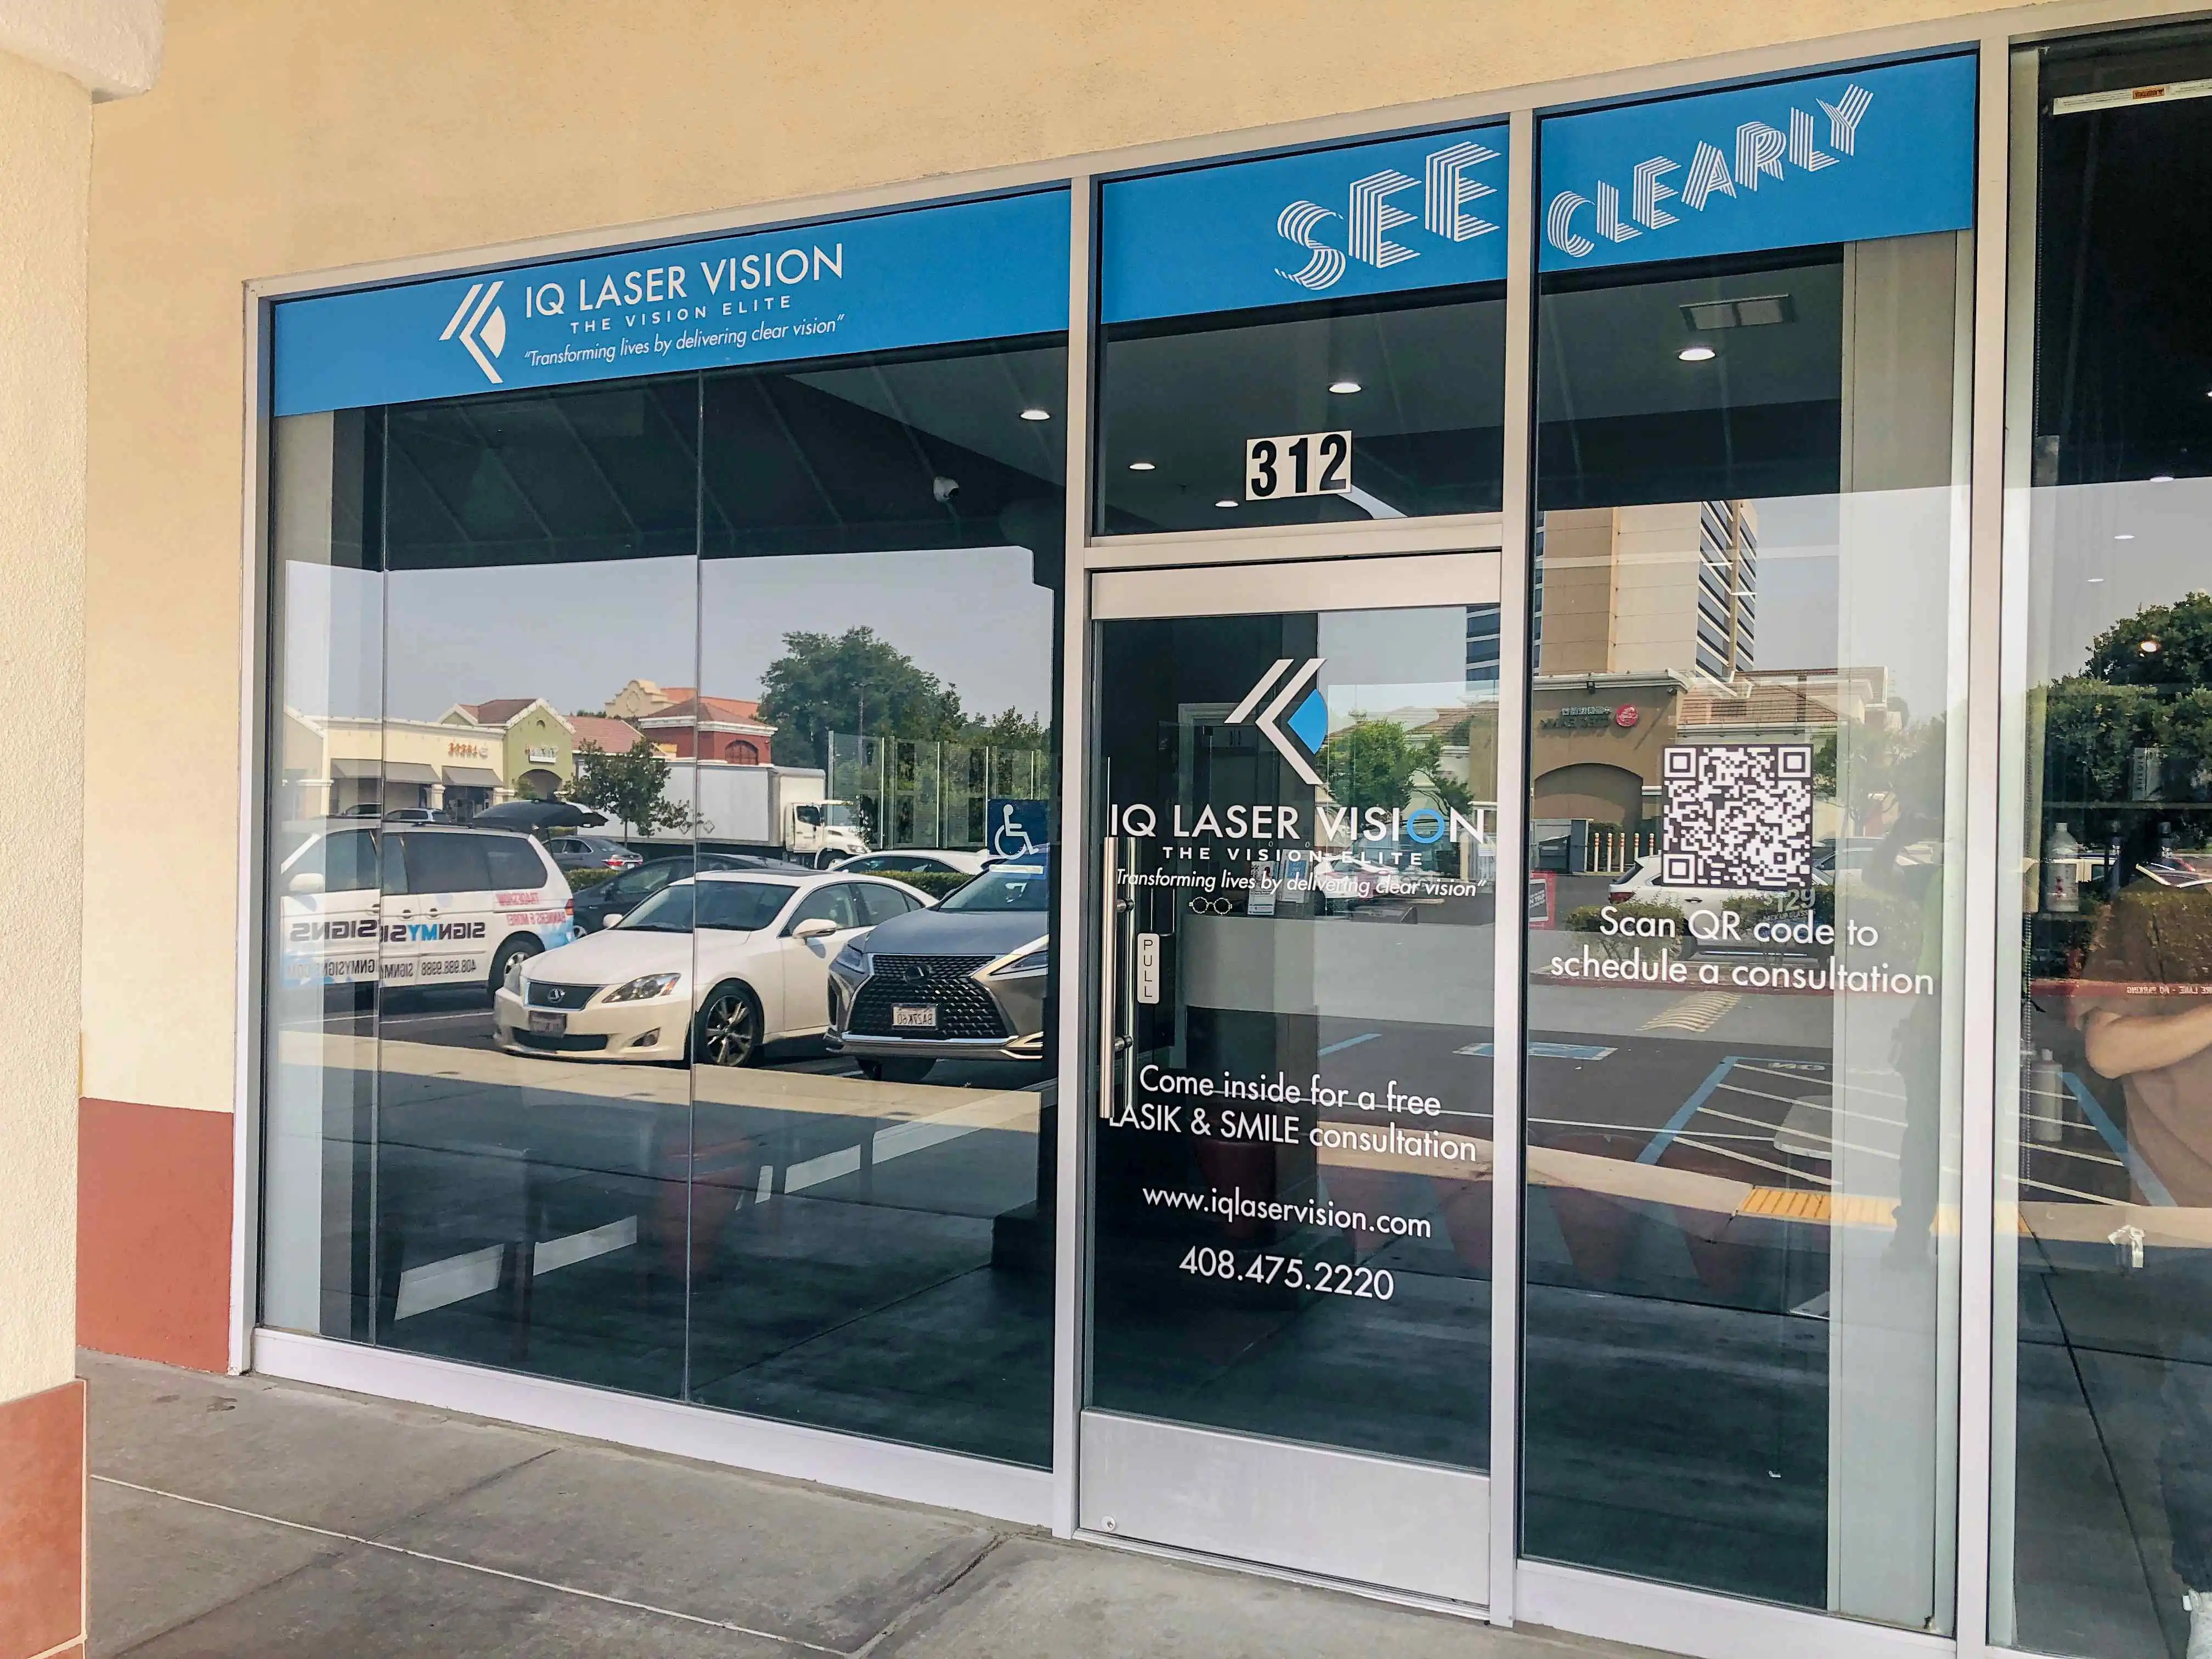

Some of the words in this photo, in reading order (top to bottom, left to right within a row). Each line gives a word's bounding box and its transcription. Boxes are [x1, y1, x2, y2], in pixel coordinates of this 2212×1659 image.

[1274, 141, 1501, 290] SEE
[1547, 84, 1874, 257] CLEARLY
[526, 283, 565, 318] IQ
[580, 266, 687, 311] LASER
[701, 243, 843, 294] VISION
[524, 344, 616, 368] "Transforming
[620, 338, 650, 356] lives
[654, 337, 670, 358] by
[676, 328, 747, 351] delivering
[751, 321, 789, 340] clear
[792, 313, 845, 336] vision"
[571, 318, 611, 334] THE
[625, 306, 707, 328] VISION
[723, 295, 792, 315] ELITE
[1251, 434, 1347, 496] 312
[1111, 803, 1156, 838] IQ
[1174, 805, 1301, 839] LASER
[1315, 806, 1484, 845] VISION
[1162, 847, 1211, 860] THE
[1227, 848, 1323, 862] VISION
[1342, 850, 1423, 866] ELITE
[1221, 871, 1256, 889] lives
[1261, 871, 1283, 895] by
[1286, 872, 1370, 897] delivering
[1376, 875, 1421, 895] clear
[1425, 879, 1487, 898] vision"
[1600, 906, 1675, 939] Scan
[1688, 909, 1741, 941] QR
[1753, 910, 1834, 944] code
[1847, 919, 1878, 947] to
[1143, 939, 1153, 997] PULL
[1551, 945, 1688, 984] schedule
[1700, 965, 1719, 984] a
[1731, 956, 1934, 995] consultation
[1139, 1064, 1214, 1096] Come
[1223, 1071, 1301, 1105] inside
[1311, 1074, 1349, 1108] for
[1358, 1092, 1376, 1110] a
[1387, 1080, 1442, 1116] free
[1190, 1109, 1211, 1136] &
[1221, 1110, 1299, 1145] SMILE
[1309, 1122, 1477, 1162] consultation
[1142, 1187, 1431, 1239] www.iqlaservision.com
[1179, 1246, 1395, 1301] 408.475.2220
